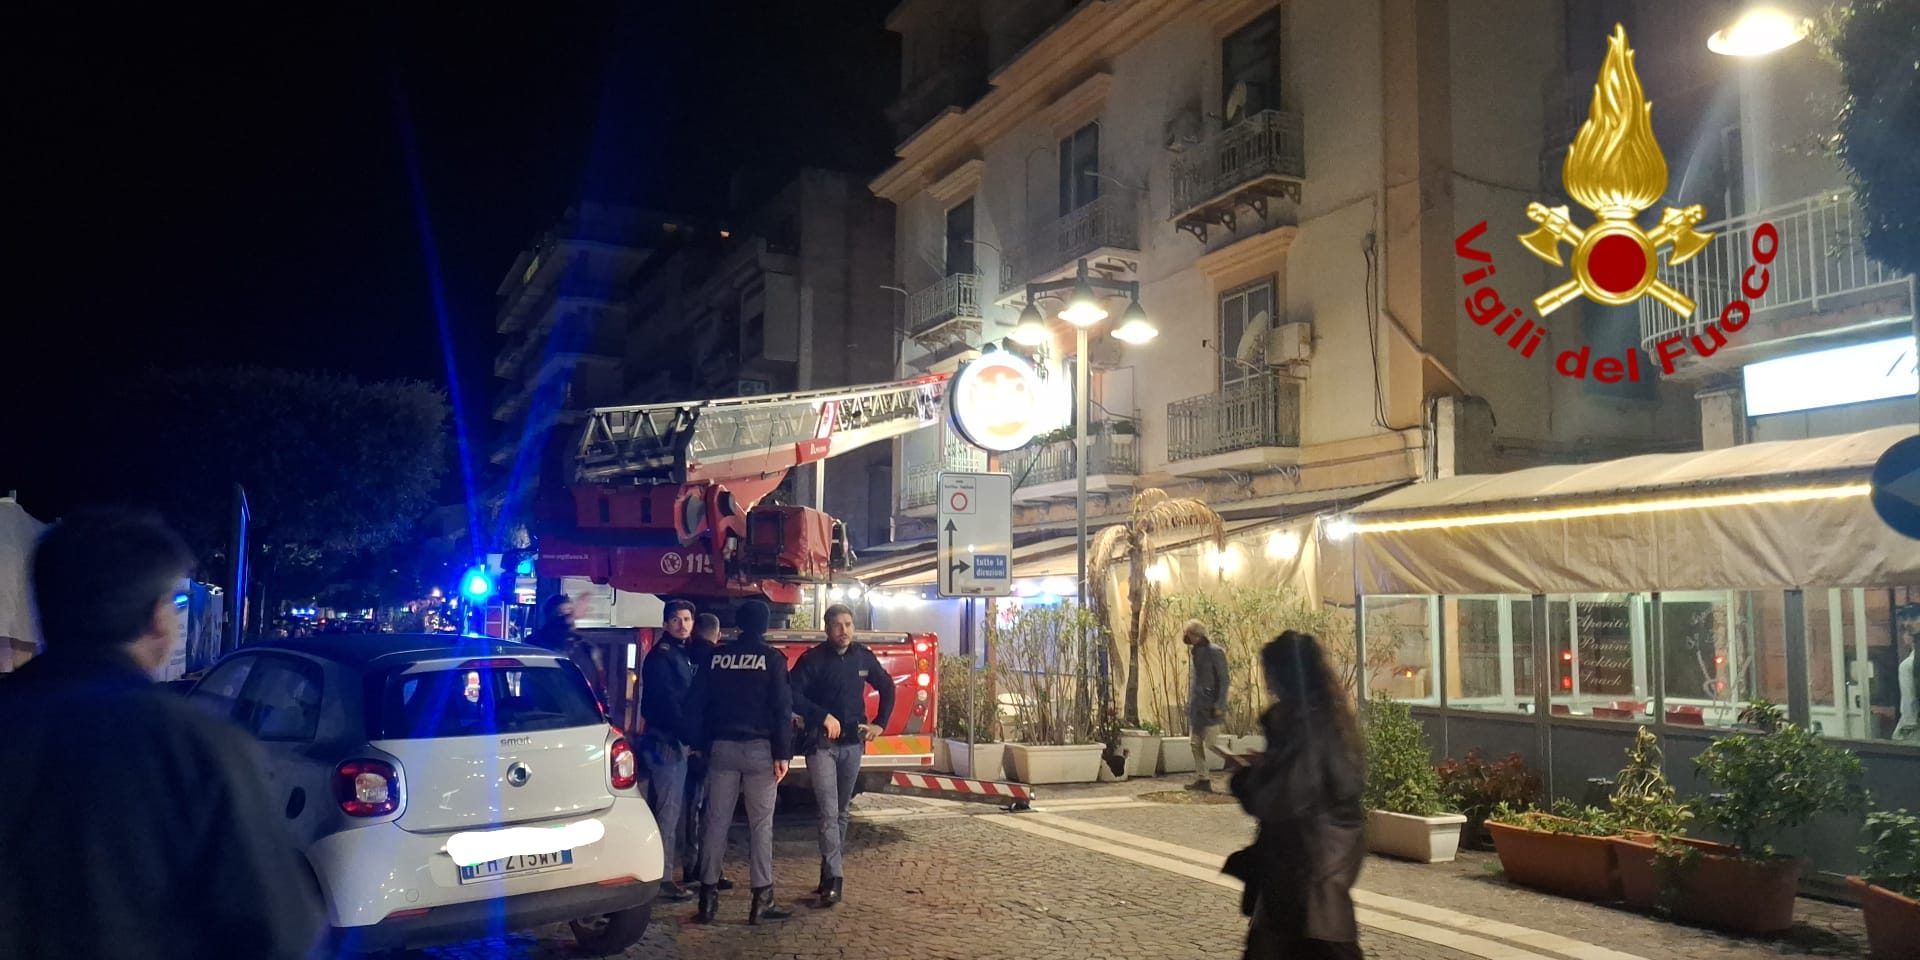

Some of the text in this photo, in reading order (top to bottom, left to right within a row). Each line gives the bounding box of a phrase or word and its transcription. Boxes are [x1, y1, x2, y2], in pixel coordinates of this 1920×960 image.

[686, 553, 714, 573] 115
[976, 557, 1005, 567] tutte le
[976, 567, 1006, 577] direzioni
[1579, 636, 1631, 650] Panini
[711, 654, 767, 671] POLIZIA
[500, 736, 530, 745] smart
